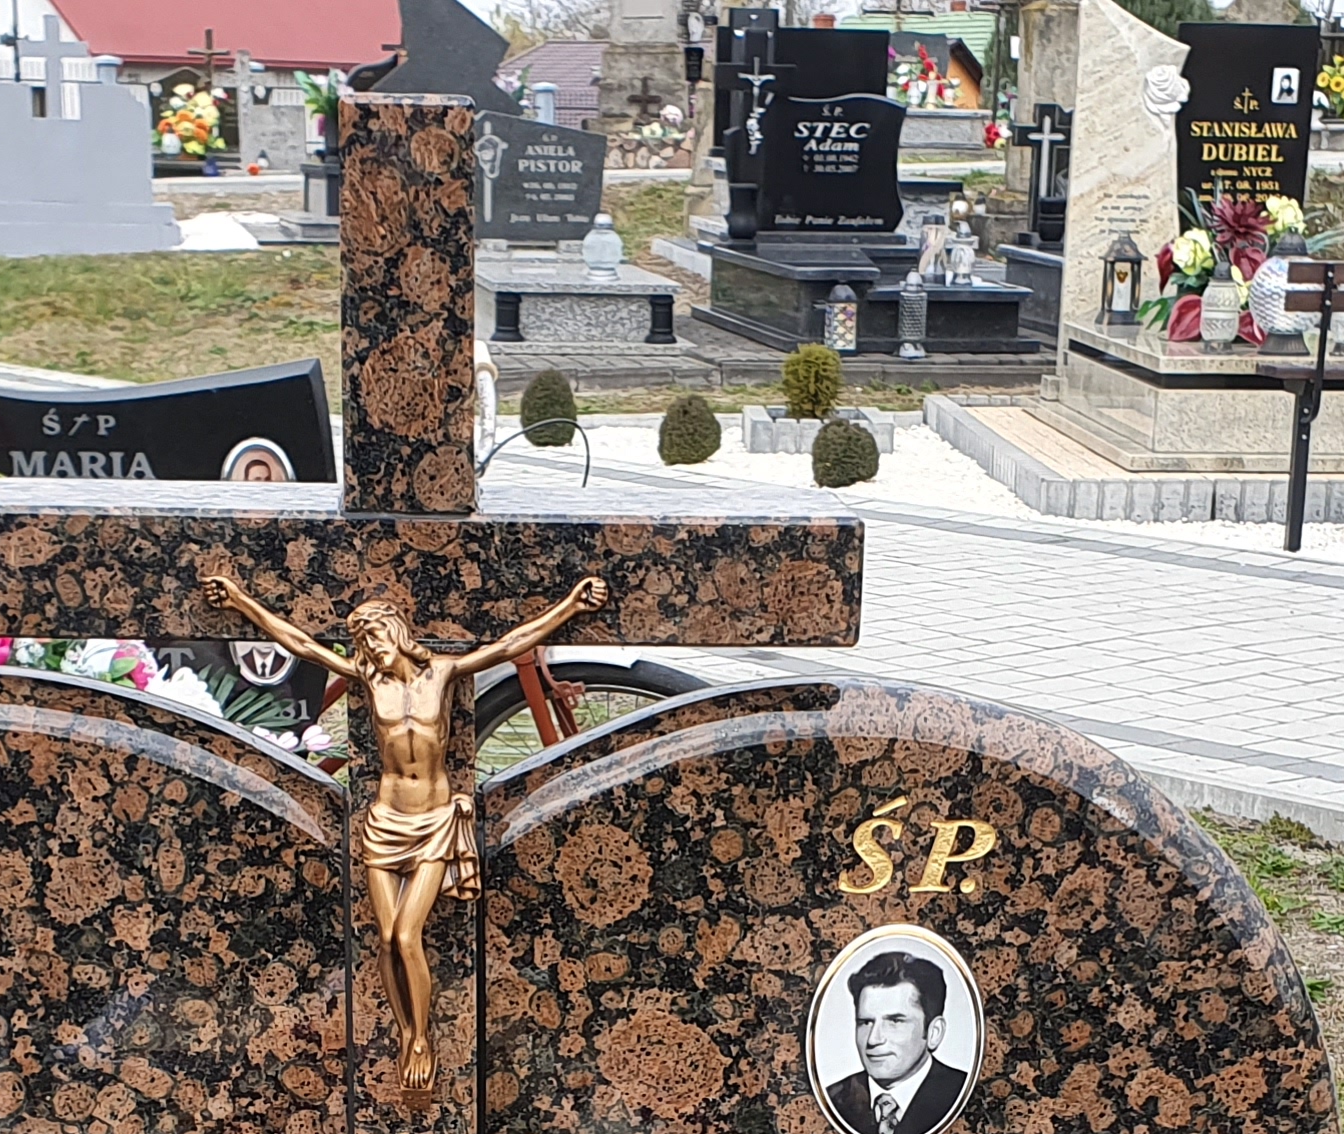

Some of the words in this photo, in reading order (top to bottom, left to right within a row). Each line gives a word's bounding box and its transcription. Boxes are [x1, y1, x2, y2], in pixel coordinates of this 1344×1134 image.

[794, 121, 871, 138] STEC
[1190, 121, 1298, 139] STANISŁAWA
[803, 138, 860, 152] Adam
[1201, 142, 1284, 162] DUBIEL
[517, 159, 584, 173] PISTOR
[1243, 166, 1273, 177] NYCZ
[8, 450, 157, 479] MARIA
